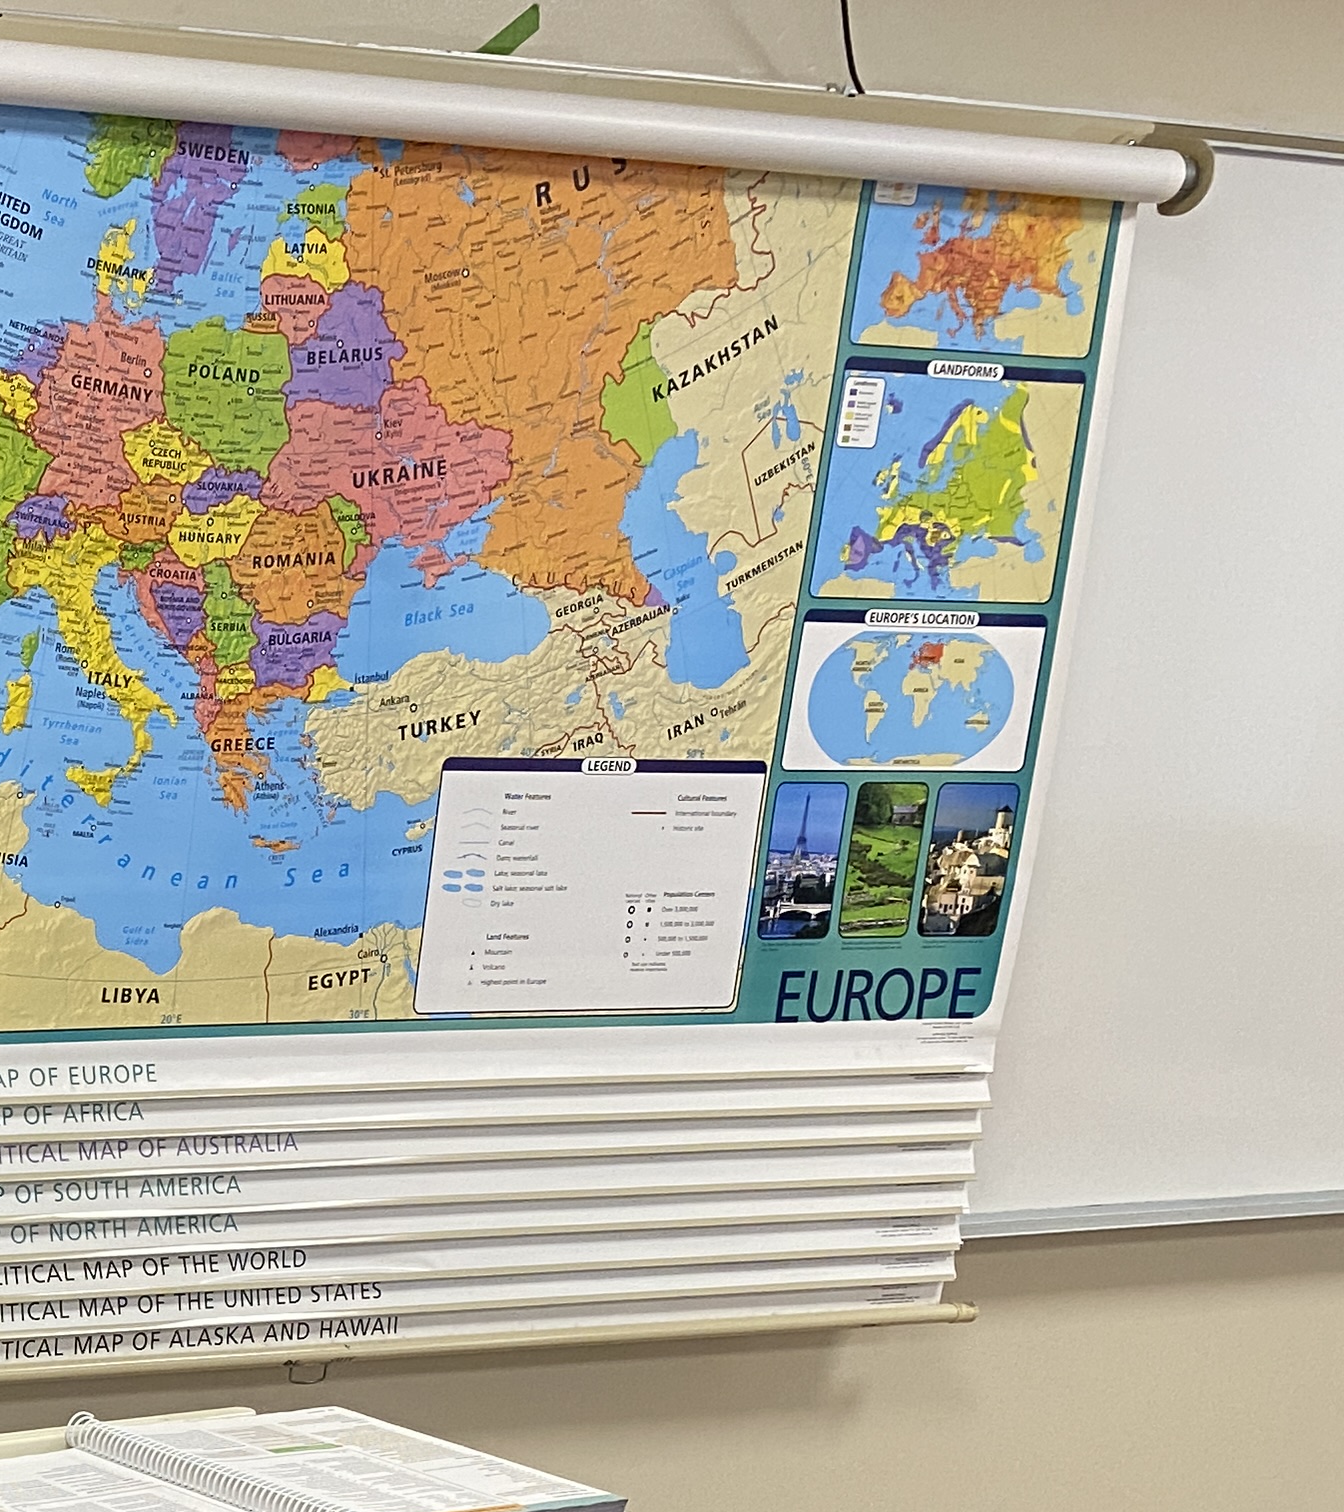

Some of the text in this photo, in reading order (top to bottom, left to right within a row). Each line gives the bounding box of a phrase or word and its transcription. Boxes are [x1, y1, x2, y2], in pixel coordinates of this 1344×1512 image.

[178, 140, 250, 165] SWEDEN
[394, 162, 442, 178] Petersburg
[41, 188, 78, 210] North
[43, 210, 65, 227] Sea
[287, 204, 336, 216] ESTONIA
[284, 243, 327, 255] LATVIA
[86, 257, 148, 282] DENMARK
[424, 270, 462, 284] Moscow
[265, 293, 325, 306] LITHUANIA
[9, 320, 66, 345] NETHERLANDS
[121, 351, 147, 367] Berlin
[307, 347, 383, 365] BELARUS
[652, 315, 780, 402] KAZAKHSTAN
[188, 364, 260, 383] POLAND
[932, 363, 999, 378] LANDFORMS
[70, 373, 154, 403] GERMANY
[152, 447, 182, 459] CZECH
[142, 458, 187, 472] REPUBLIC
[352, 459, 447, 488] UKRAINE
[754, 442, 816, 486] UZBEKISTAN
[196, 481, 244, 492] SLOVAKIA
[15, 511, 70, 530] SWITZERLAND
[119, 512, 166, 527] AUSTRIA
[179, 532, 241, 545] HUNGARY
[252, 551, 336, 569] ROMANIA
[725, 541, 804, 592] TURKMENISTAN
[149, 568, 197, 581] CROATIA
[404, 601, 475, 627] Black Sea
[555, 594, 603, 618] GEORGIA
[211, 622, 247, 632] SERBIA
[612, 604, 671, 637] AZERBAIJAN
[922, 612, 975, 625] LOCATION
[268, 631, 333, 646] BULGARIA
[87, 671, 133, 688] ITALY
[75, 687, 106, 700] Naples
[379, 694, 409, 707] Ankara
[398, 711, 481, 742] TURKEY
[667, 713, 705, 741] IRAN
[211, 737, 275, 752] GREECE
[572, 733, 604, 752] IRAQ
[587, 760, 632, 772] LEGEND
[285, 863, 350, 886] Sea
[314, 924, 359, 938] Alexandria
[308, 968, 371, 990] EGYPT
[101, 987, 160, 1003] LIBYA
[775, 967, 982, 1022] EUROPE
[29, 1067, 58, 1086] OF
[69, 1063, 157, 1085] EUROPE
[24, 1105, 52, 1124] OF
[64, 1101, 144, 1123] AFRICA
[78, 1140, 128, 1160] MAP
[138, 1138, 166, 1157] OF
[177, 1133, 298, 1156] AUSTRALIA
[15, 1184, 43, 1203] OF
[53, 1180, 129, 1201] SOUTH
[140, 1176, 241, 1197] AMERICA
[11, 1224, 39, 1244] OF
[50, 1219, 126, 1241] NORTH
[137, 1214, 239, 1236] AMERICA
[84, 1260, 133, 1280] MAP
[143, 1257, 170, 1276] OF
[178, 1254, 219, 1274] THE
[228, 1250, 307, 1271] WORLD
[78, 1297, 128, 1317] MAP
[138, 1295, 165, 1313] OF
[174, 1291, 214, 1311] THE
[224, 1286, 301, 1309] UNITED
[310, 1281, 382, 1303] STATES
[74, 1334, 123, 1356] MAP
[133, 1332, 160, 1351] OF
[169, 1325, 254, 1349] ALASKA
[264, 1322, 310, 1342] AND
[319, 1317, 398, 1339] HAWAII
